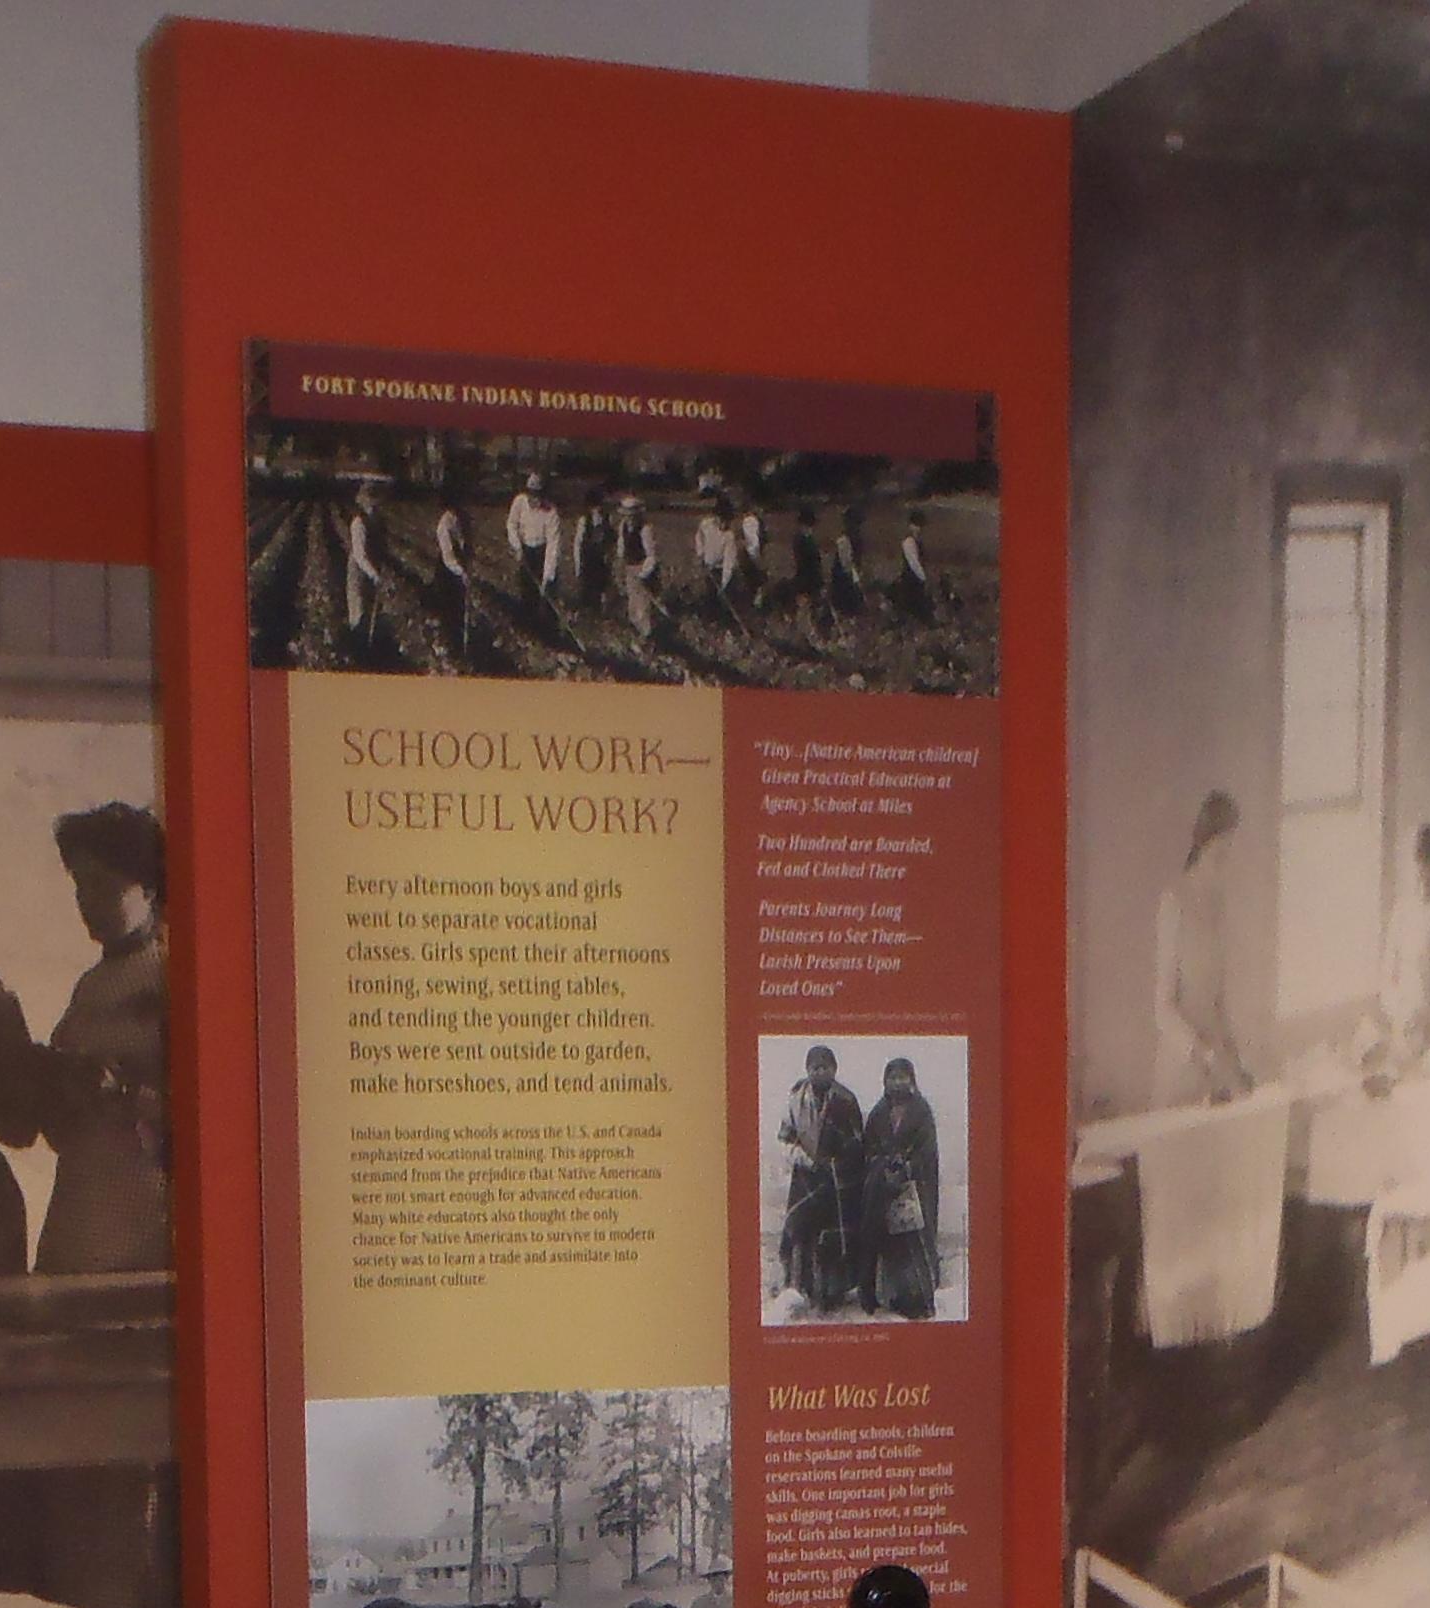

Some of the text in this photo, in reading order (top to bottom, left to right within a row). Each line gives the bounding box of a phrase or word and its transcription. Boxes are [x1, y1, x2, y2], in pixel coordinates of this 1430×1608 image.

[302, 375, 726, 420] FORT SPOKANE INDIAN BOARDING SCHOOL
[342, 727, 521, 771] SCHOOL
[856, 744, 915, 763] American
[761, 771, 951, 788] Given Practical Education at
[345, 791, 680, 834] USEFUL WORK?
[761, 795, 857, 814] Agency School
[757, 834, 872, 852] Two Hundred are
[757, 862, 907, 879] Fed and Clothed There
[346, 874, 622, 902] Every afternoon boys and girls
[759, 900, 902, 922] Parents Journey Long
[346, 910, 597, 933] went to separate vocational
[759, 927, 868, 944] Distances to See
[346, 942, 670, 967] classes. Girls spent their afternoons
[807, 954, 901, 974] Presents Upon
[348, 976, 625, 1000] ironing, sewing, setting tables,
[759, 980, 797, 996] Loved
[348, 1009, 654, 1032] and tending the younger children.
[350, 1041, 651, 1065] Boys were sent outside to garden,
[350, 1073, 672, 1095] make horseshoes, and tend animals.
[351, 1126, 661, 1143] Indian boarding schools across the and Canada
[350, 1147, 634, 1163] emphasized vocational This approach
[352, 1167, 661, 1184] stemmed from the prejudice that Native Americans
[352, 1188, 642, 1205] were not smart enough for advanced education.
[353, 1209, 619, 1228] Many white educators also thought the only
[353, 1229, 655, 1246] chance for Native Americans to survive in modern
[353, 1249, 638, 1269] society was to learn a trade and assimilate into
[353, 1273, 437, 1289] the dominant
[769, 1383, 931, 1410] What Was Lost
[805, 1428, 856, 1444] boarding
[784, 1447, 876, 1465] the Spokane and
[766, 1466, 881, 1483] reservations learned
[828, 1485, 925, 1503] important job for
[791, 1509, 832, 1525] digging
[828, 1524, 910, 1540] also learned to
[849, 1545, 870, 1558] and
[930, 1579, 967, 1592] for the
